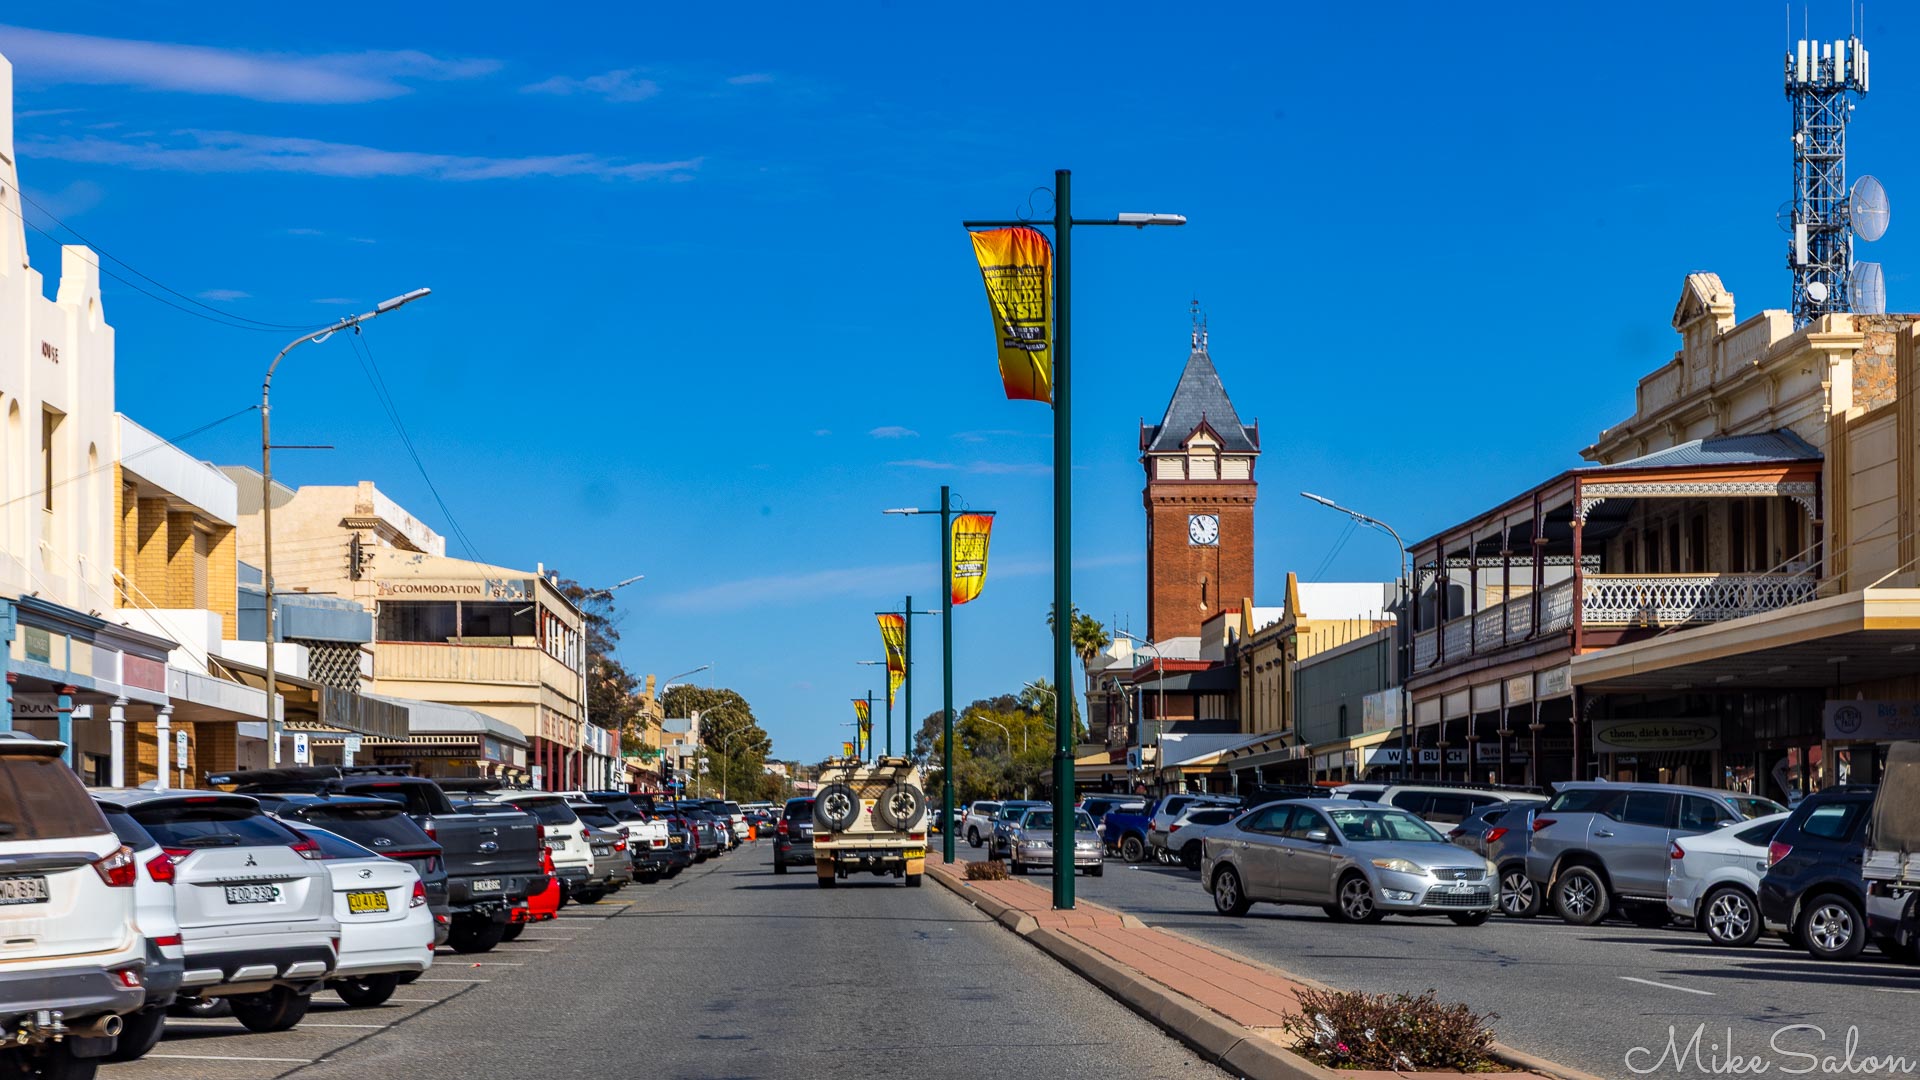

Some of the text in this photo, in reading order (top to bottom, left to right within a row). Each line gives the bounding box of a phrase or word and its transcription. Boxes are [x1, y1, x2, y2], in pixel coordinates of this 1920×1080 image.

[376, 580, 481, 596] ACCOMMODATION
[1609, 729, 1637, 738] thom,
[1639, 728, 1660, 737] dick
[1662, 728, 1669, 736] &
[1423, 751, 1462, 761] BUCH
